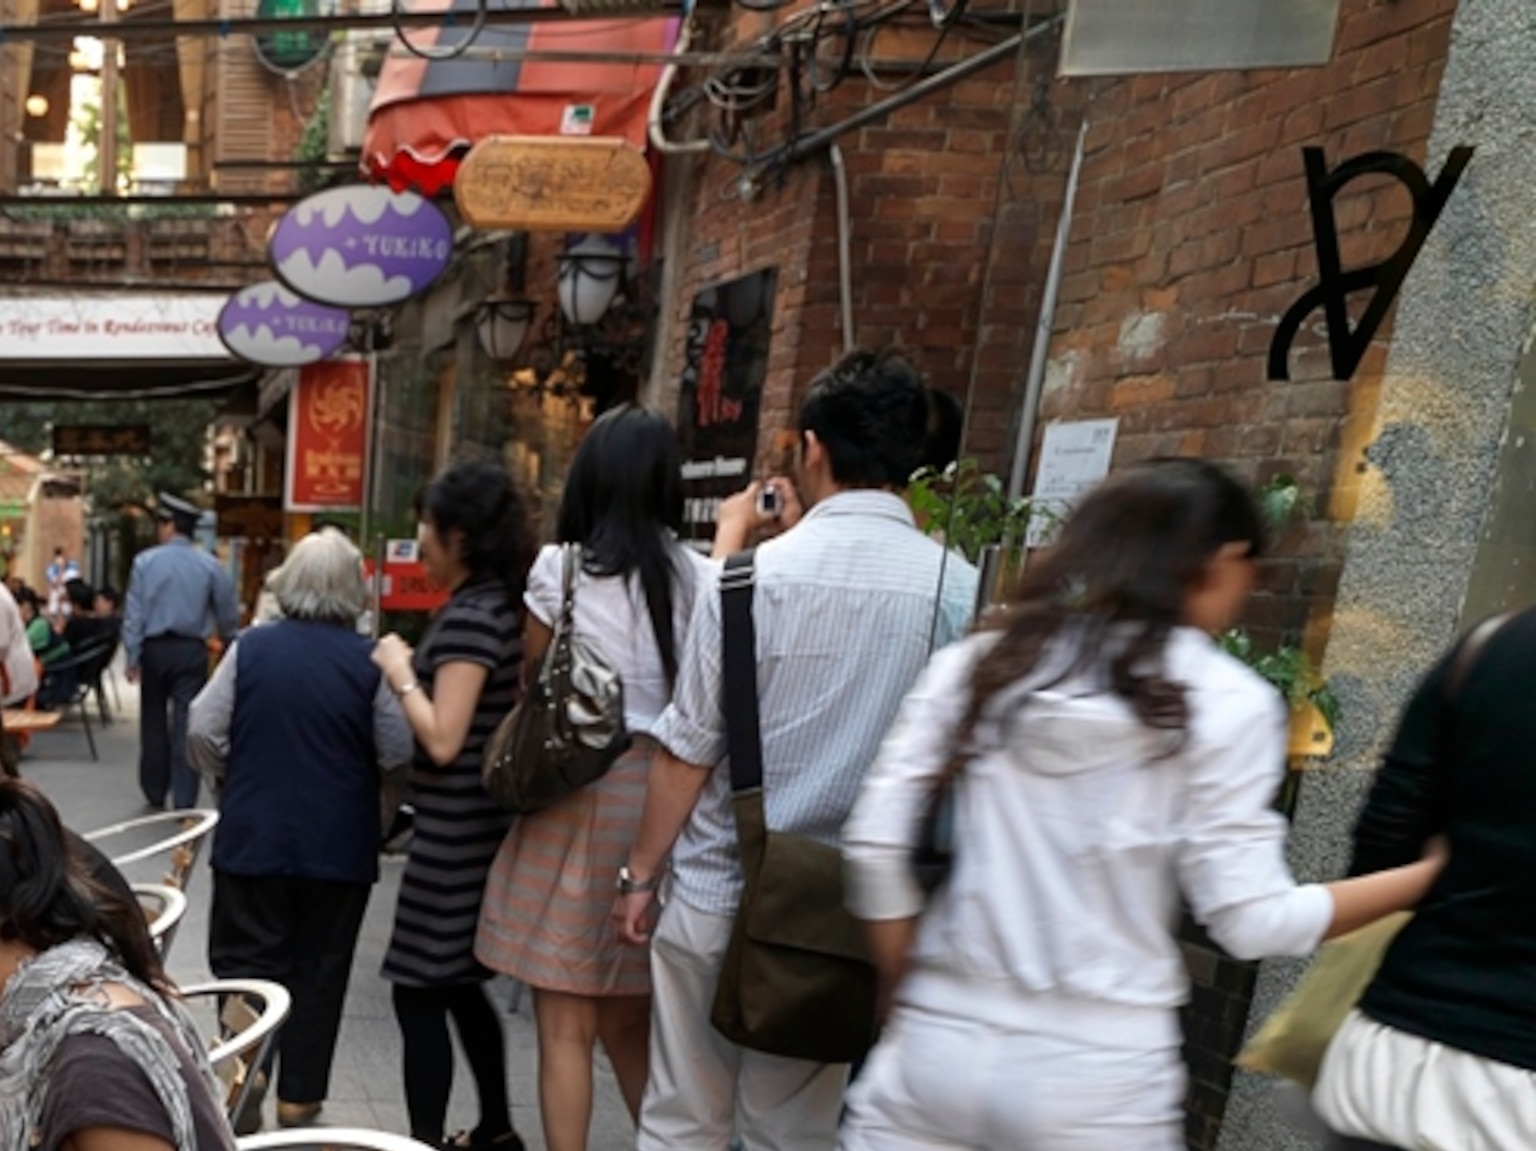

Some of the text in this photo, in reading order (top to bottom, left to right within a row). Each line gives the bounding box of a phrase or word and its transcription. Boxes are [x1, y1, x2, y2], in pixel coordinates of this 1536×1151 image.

[47, 318, 79, 335] Time
[85, 318, 98, 334] in
[192, 318, 220, 336] Caf
